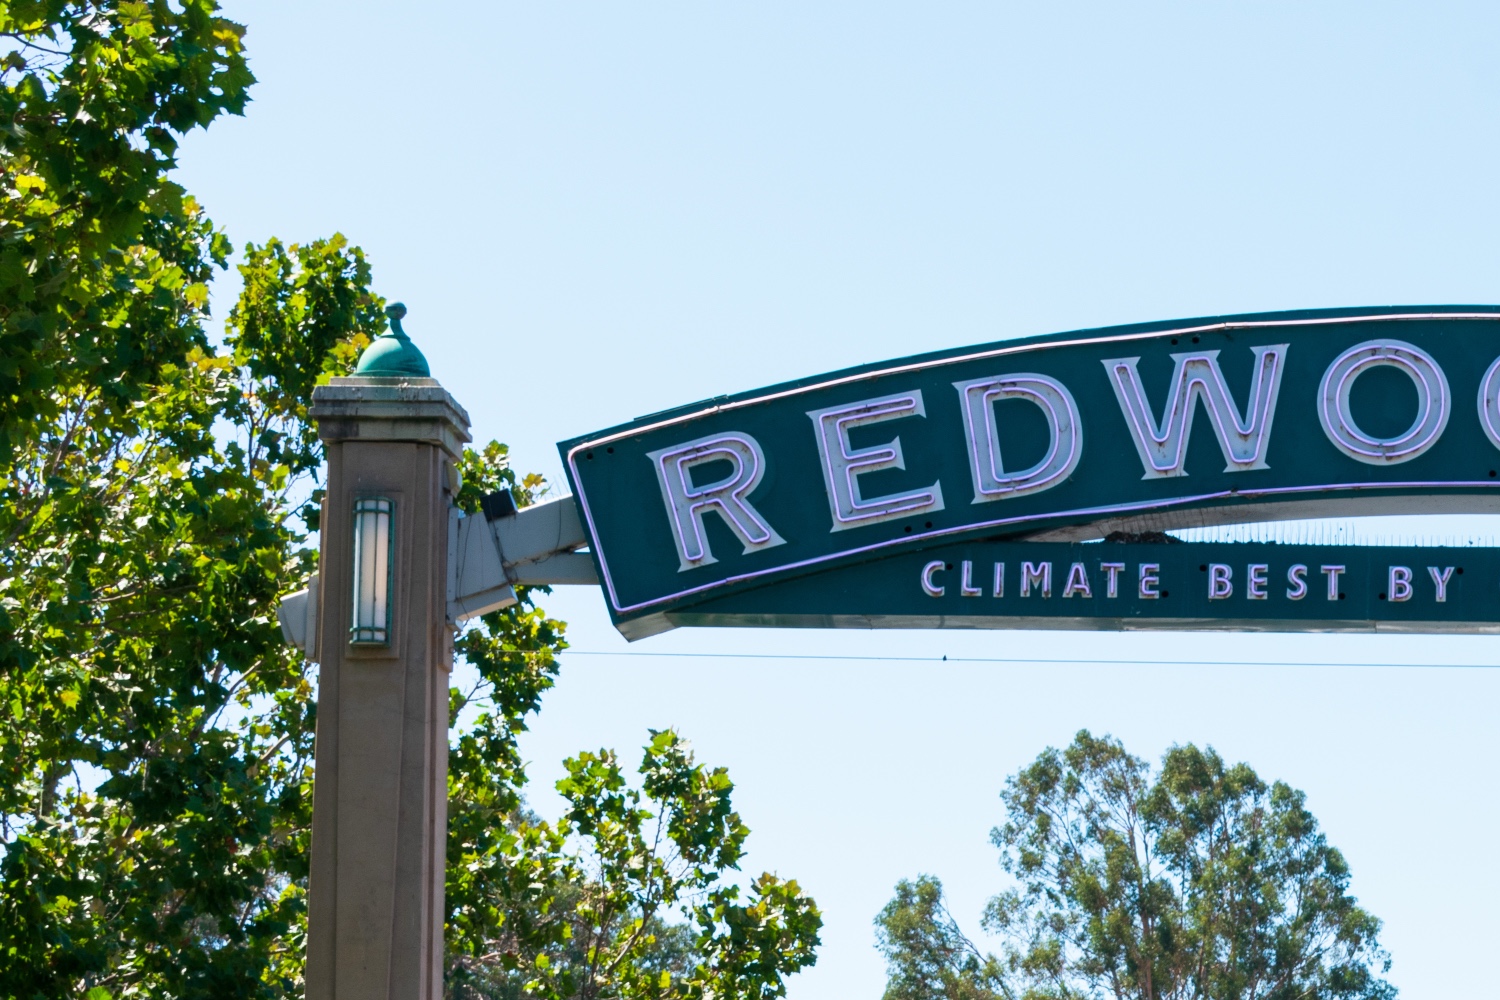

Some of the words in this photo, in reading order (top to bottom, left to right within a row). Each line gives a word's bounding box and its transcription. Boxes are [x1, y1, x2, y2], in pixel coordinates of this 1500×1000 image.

[920, 560, 1161, 600] CLIMATE
[1207, 563, 1346, 601] BEST
[1388, 565, 1455, 603] BY
